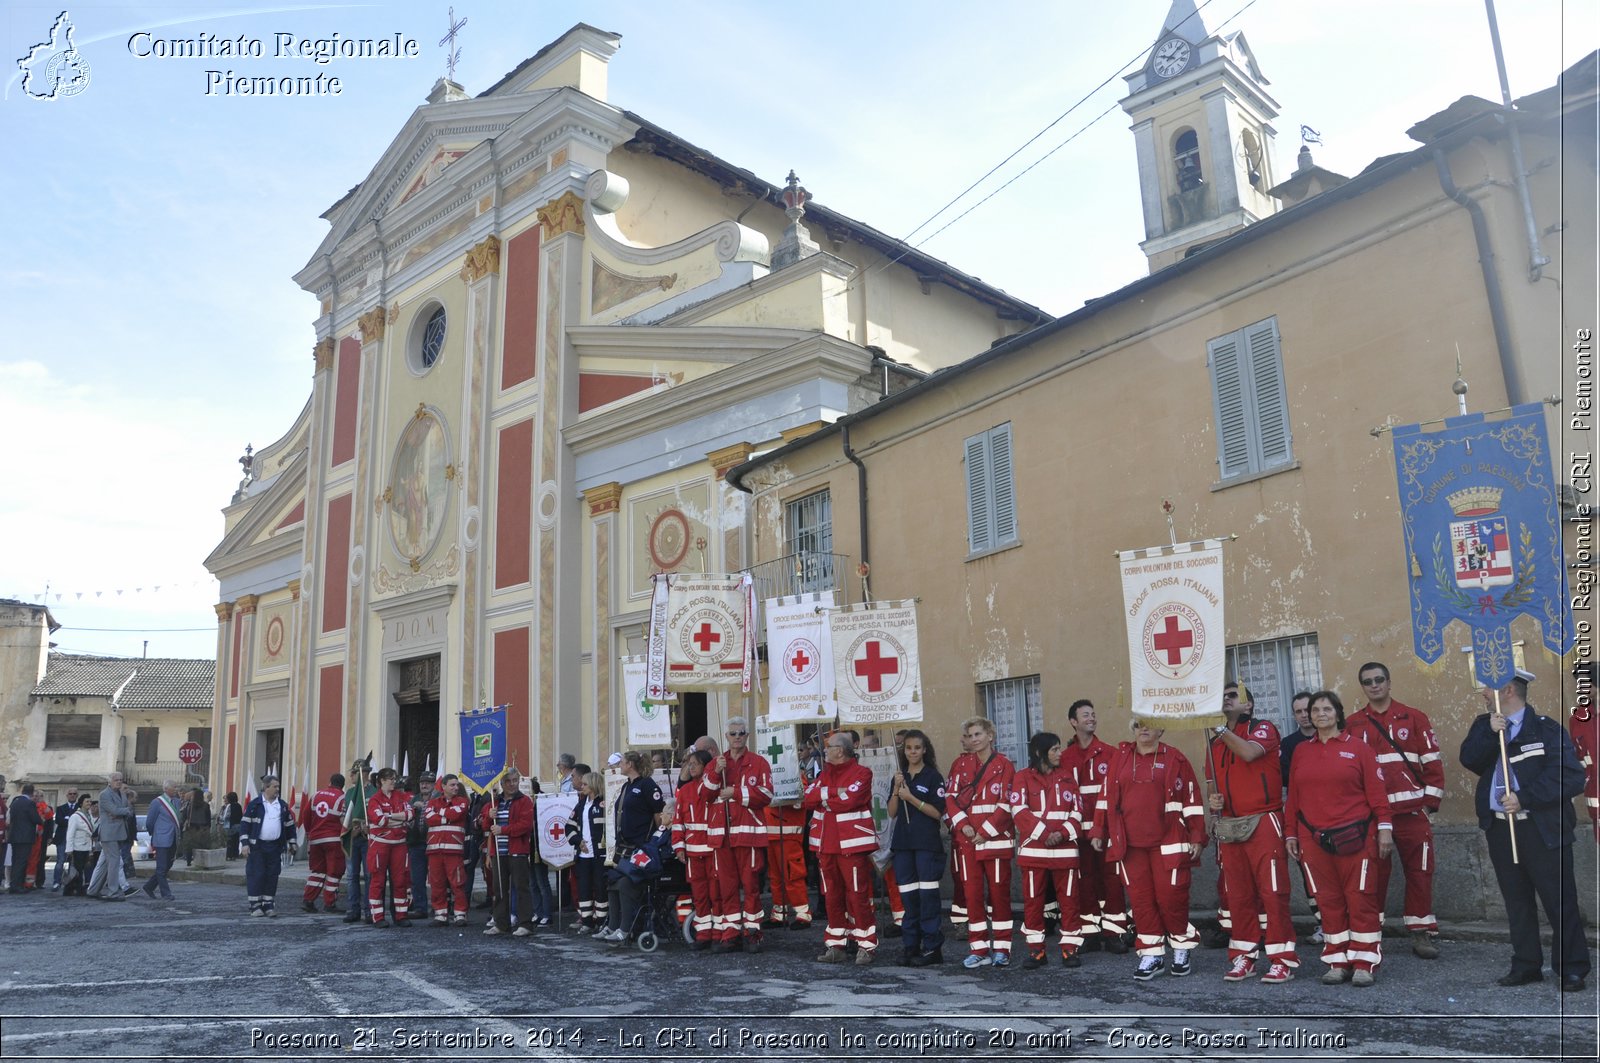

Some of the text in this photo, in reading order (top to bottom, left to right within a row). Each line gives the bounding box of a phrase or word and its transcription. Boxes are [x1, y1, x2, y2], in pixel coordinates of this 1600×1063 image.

[1424, 463, 1525, 503] COMUNE DI PAESANA
[1124, 556, 1218, 576] CORPO VOLONTARI DEL SOCCORSO
[1129, 577, 1219, 617] CROCE ROSSA ITALIANA
[669, 595, 745, 631] CROCE ROSSA ITALIANA
[1159, 604, 1186, 615] GINEVRA
[1186, 610, 1195, 619] 22
[1152, 612, 1159, 620] DI
[832, 619, 915, 632] CROCE ROSSA ITALIANA
[1193, 618, 1204, 650] AGOSTO
[1144, 619, 1161, 670] CONVENZIONE
[1142, 685, 1209, 697] DELEGAZIONE DI
[777, 694, 819, 703] DELEGAZIONE
[850, 703, 908, 713] DELEGAZIONE DI
[1153, 702, 1196, 713] PAESANA
[855, 713, 899, 722] DRONERO
[180, 748, 201, 758] STOP
